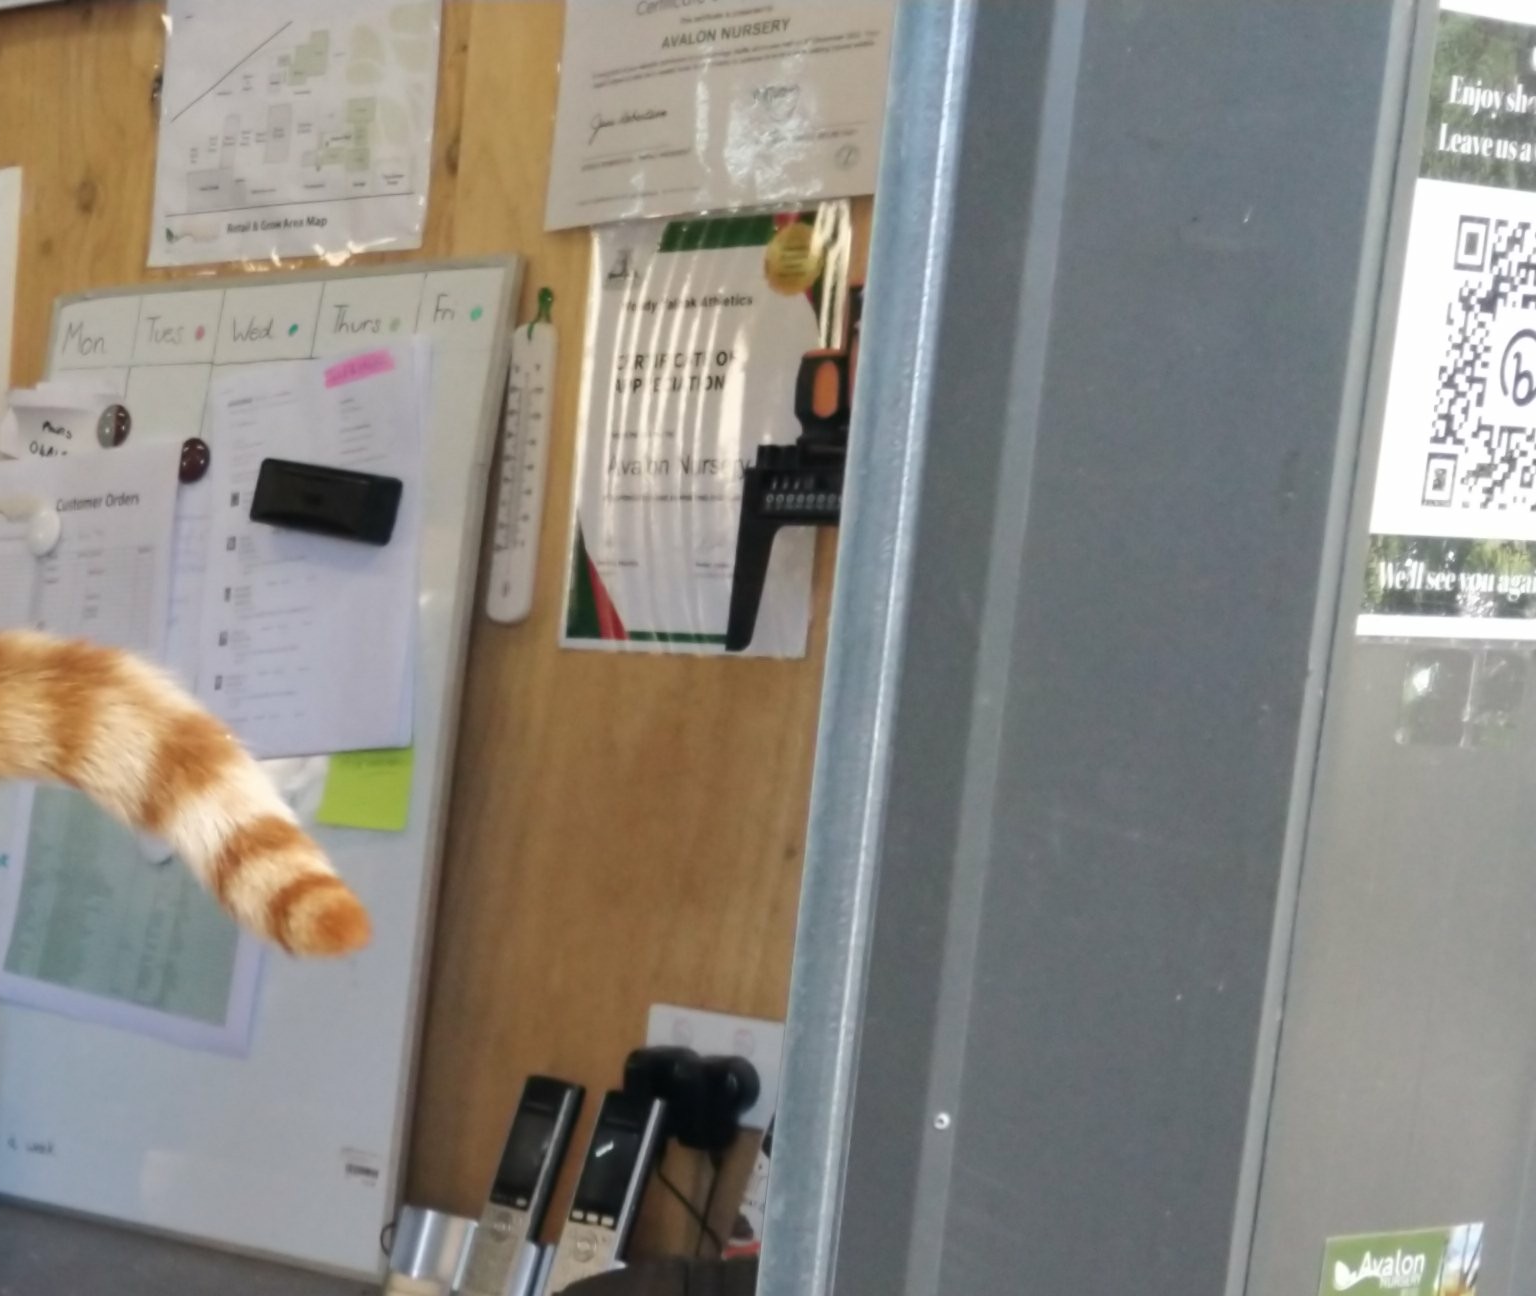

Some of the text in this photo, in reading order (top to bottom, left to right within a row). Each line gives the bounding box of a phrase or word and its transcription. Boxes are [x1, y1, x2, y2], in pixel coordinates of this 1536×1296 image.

[661, 18, 791, 49] AVALON NURSERY
[1448, 75, 1504, 117] Enjoy
[1438, 123, 1494, 157] Leave
[1495, 138, 1519, 161] us
[227, 222, 251, 234] Retail
[260, 219, 282, 231] Grow
[283, 218, 305, 229] Area
[305, 216, 328, 230] Map
[62, 293, 456, 356] Mon Tues Wed Thurs Fri
[56, 492, 140, 512] Customer Orders
[1426, 570, 1457, 591] see
[1459, 571, 1496, 597] you
[1359, 1248, 1426, 1276] Avalon
[1379, 1271, 1422, 1289] NURSERY
